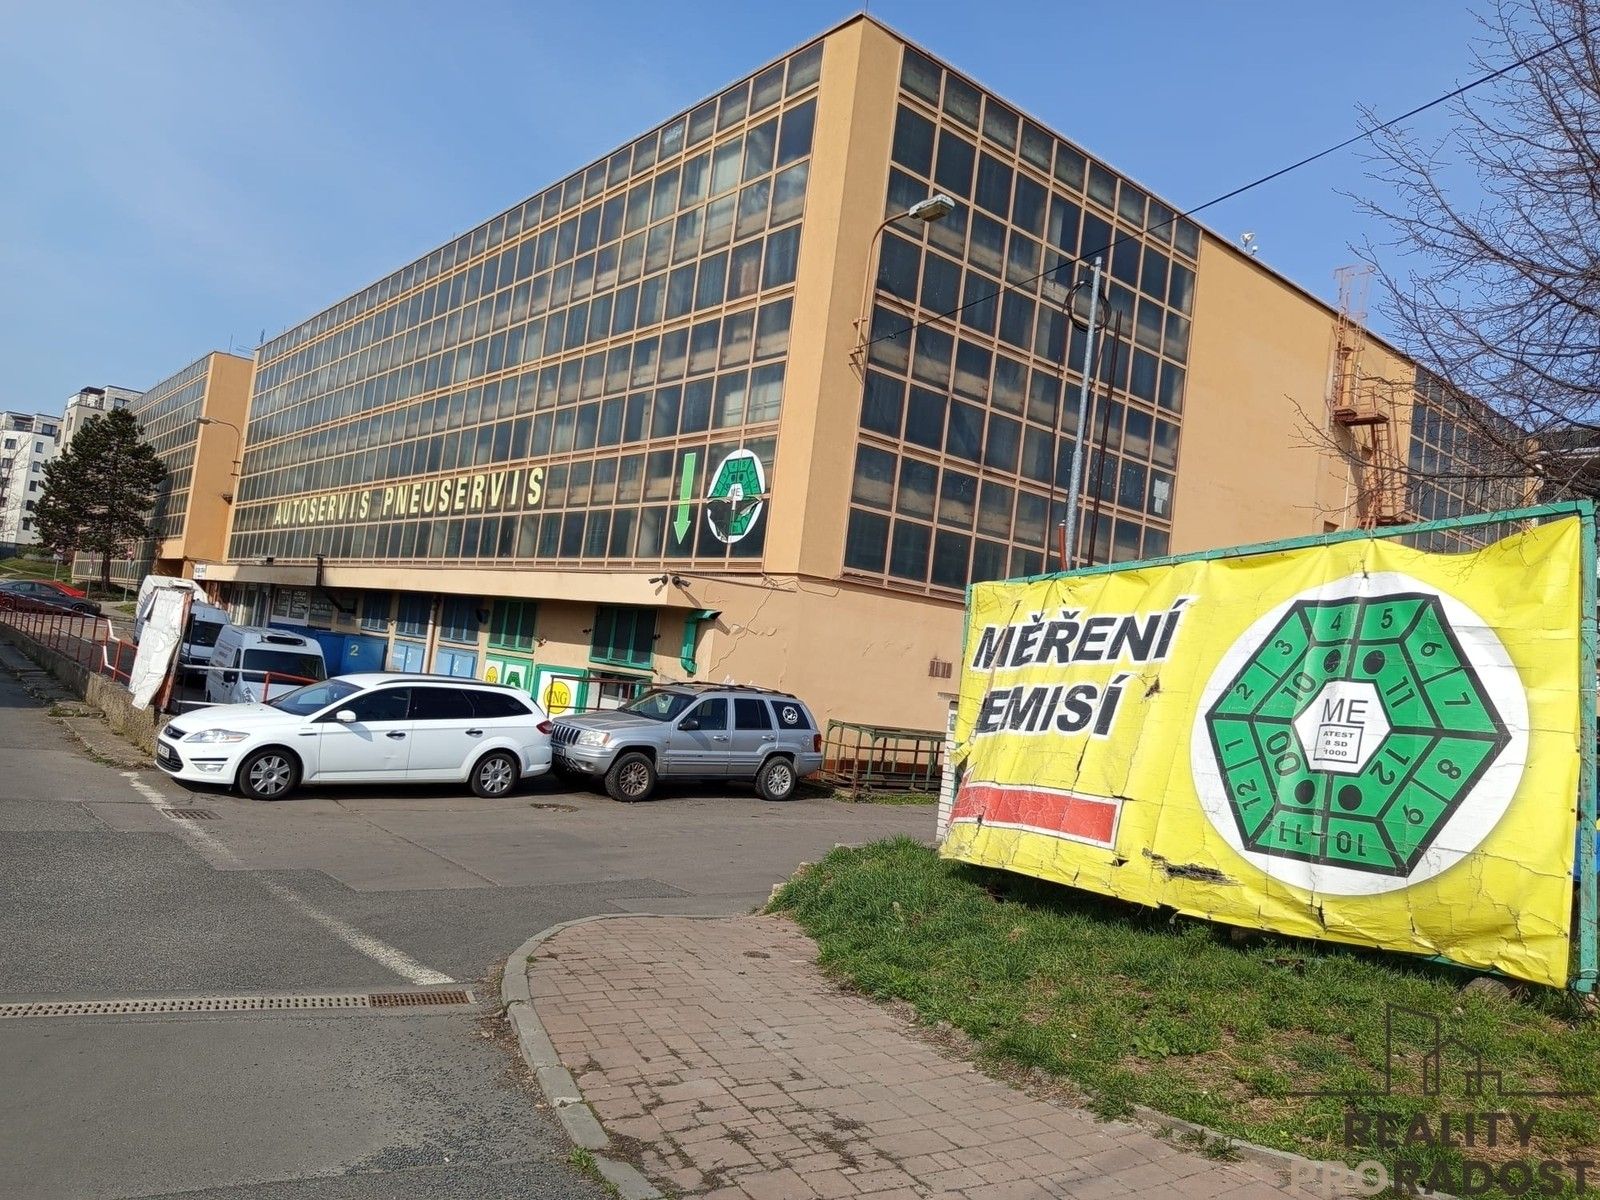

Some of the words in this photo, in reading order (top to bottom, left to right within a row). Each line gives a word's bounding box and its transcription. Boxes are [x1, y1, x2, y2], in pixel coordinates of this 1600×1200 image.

[274, 491, 370, 526] AUTOSERVIS
[382, 467, 545, 517] PNEUSERVIS
[1329, 611, 1343, 632] 4
[1380, 607, 1394, 630] 5
[972, 598, 1189, 669] MĚŘENÍ
[349, 644, 360, 657] 2
[1274, 639, 1294, 656] 3
[1235, 682, 1255, 701] 2
[1280, 671, 1317, 703] 10
[1385, 675, 1416, 709] 11
[1443, 691, 1472, 706] 7
[976, 674, 1130, 736] EMISÍ
[1321, 698, 1369, 724] ME
[1224, 738, 1244, 752] 1
[1323, 730, 1355, 739] ATEST
[1333, 740, 1348, 748] SD
[1323, 748, 1348, 757] 1000
[1368, 747, 1412, 786] 12
[1436, 758, 1462, 780] 8
[1236, 778, 1261, 811] 12
[1278, 820, 1304, 846] 11
[1336, 830, 1367, 857] 10
